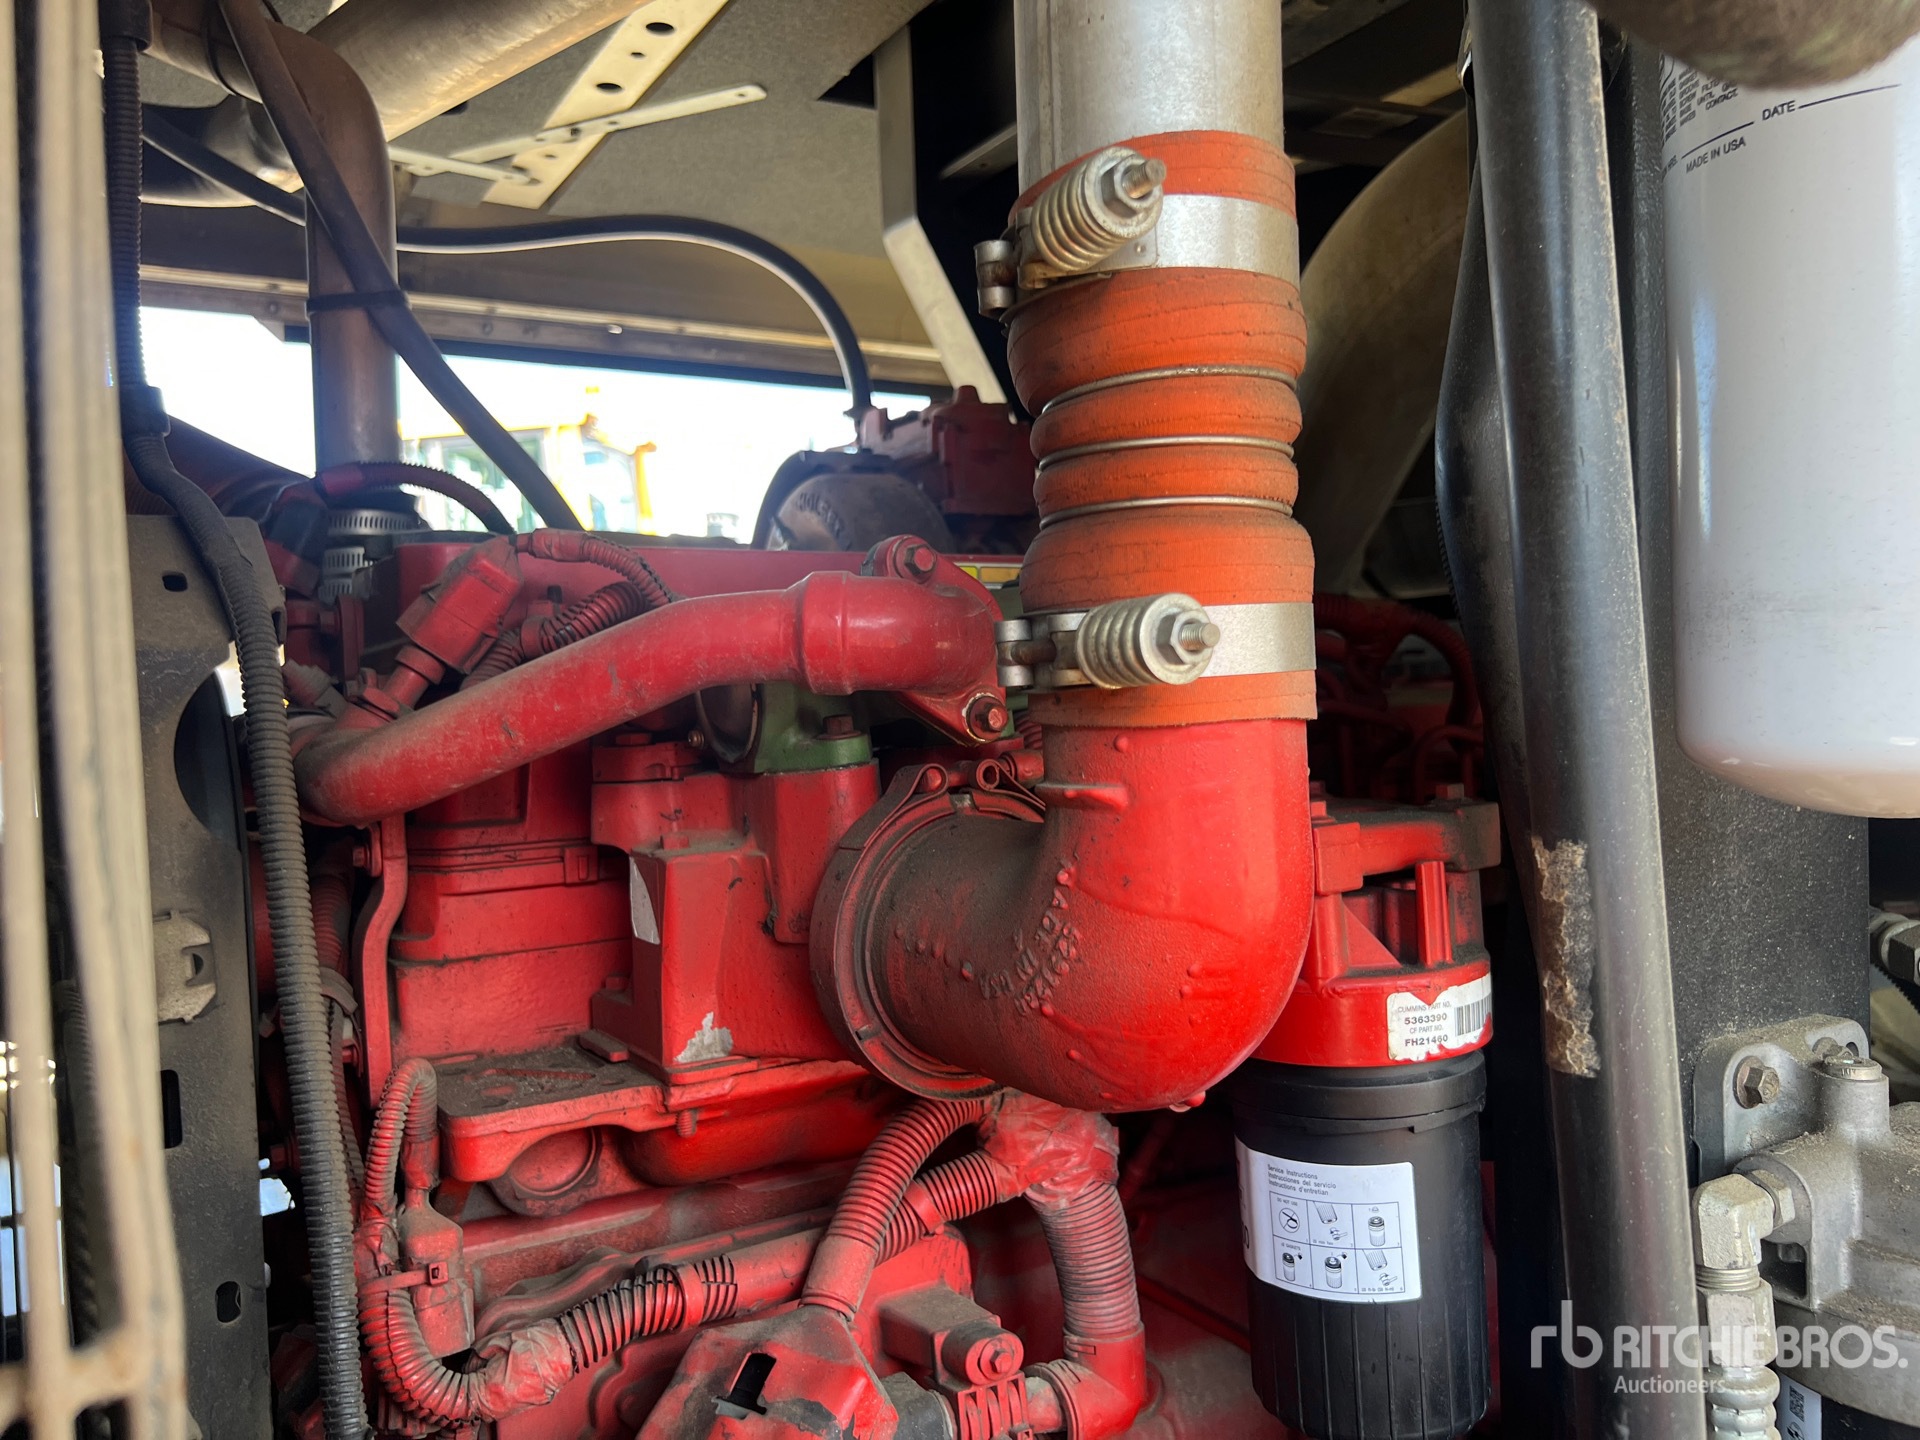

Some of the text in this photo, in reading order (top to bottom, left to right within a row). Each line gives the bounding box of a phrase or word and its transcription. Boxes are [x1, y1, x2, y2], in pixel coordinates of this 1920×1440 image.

[1705, 87, 1740, 111] CONTACT
[1761, 100, 1796, 121] DATE
[1685, 152, 1709, 174] MADE
[1710, 145, 1721, 161] IN
[1723, 136, 1747, 155] USA
[1397, 1004, 1427, 1014] CUMMINS
[1404, 1012, 1448, 1025] 5363390
[1418, 1025, 1433, 1034] PART
[1404, 1034, 1449, 1047] FH21460
[1267, 1163, 1318, 1180] Service Instructions
[1267, 1171, 1300, 1185] Instrucciones
[1313, 1181, 1337, 1189] servicio
[1268, 1179, 1297, 1191] Instructions
